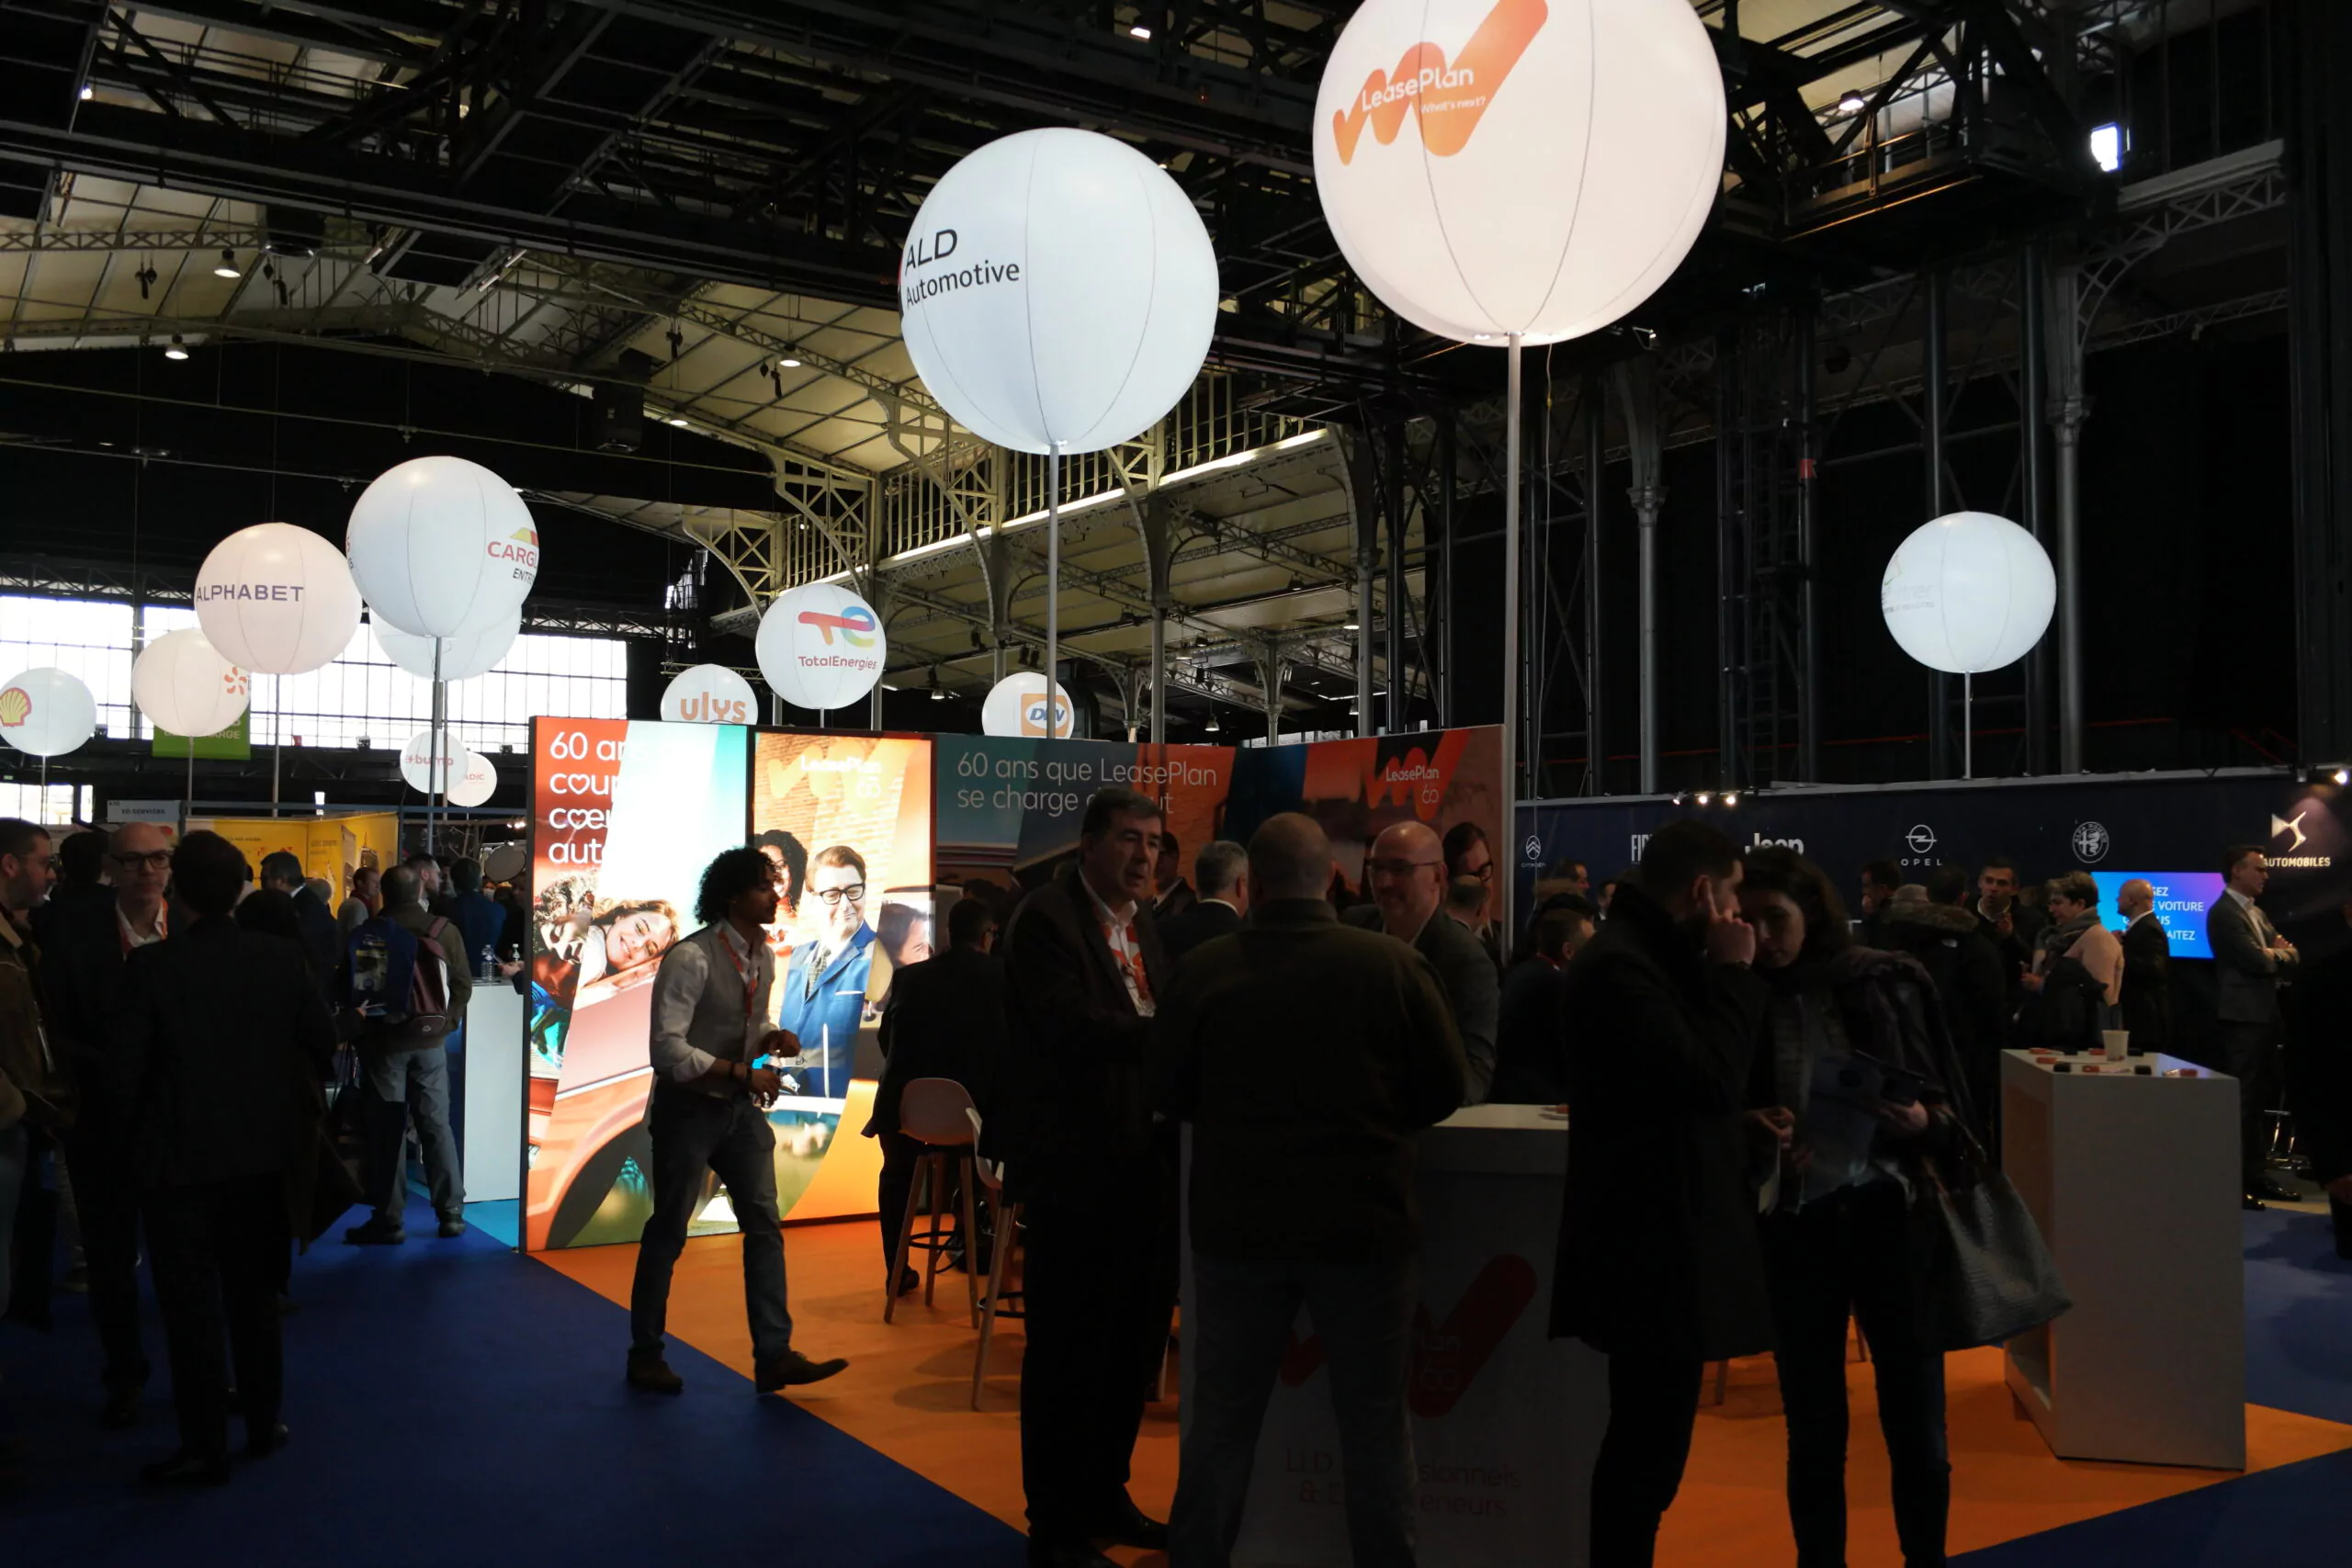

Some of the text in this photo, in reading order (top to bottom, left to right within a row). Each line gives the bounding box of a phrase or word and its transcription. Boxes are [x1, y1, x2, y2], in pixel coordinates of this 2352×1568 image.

[1362, 67, 1475, 112] LeasePlan
[905, 229, 958, 276] ALD
[906, 259, 1020, 310] Automotive
[196, 583, 304, 603] ALPHABET
[797, 655, 877, 671] TotalEnergies
[680, 691, 746, 724] ulys
[549, 731, 588, 761] 60
[957, 751, 1217, 787] 60 ans que LeasePlan
[1385, 763, 1440, 783] LeasePlan
[956, 787, 985, 809] se
[992, 783, 1080, 818] charge
[1900, 858, 1943, 866] OPEL
[2263, 856, 2331, 867] AUTOMOBILES
[2157, 900, 2205, 912] VOITURE
